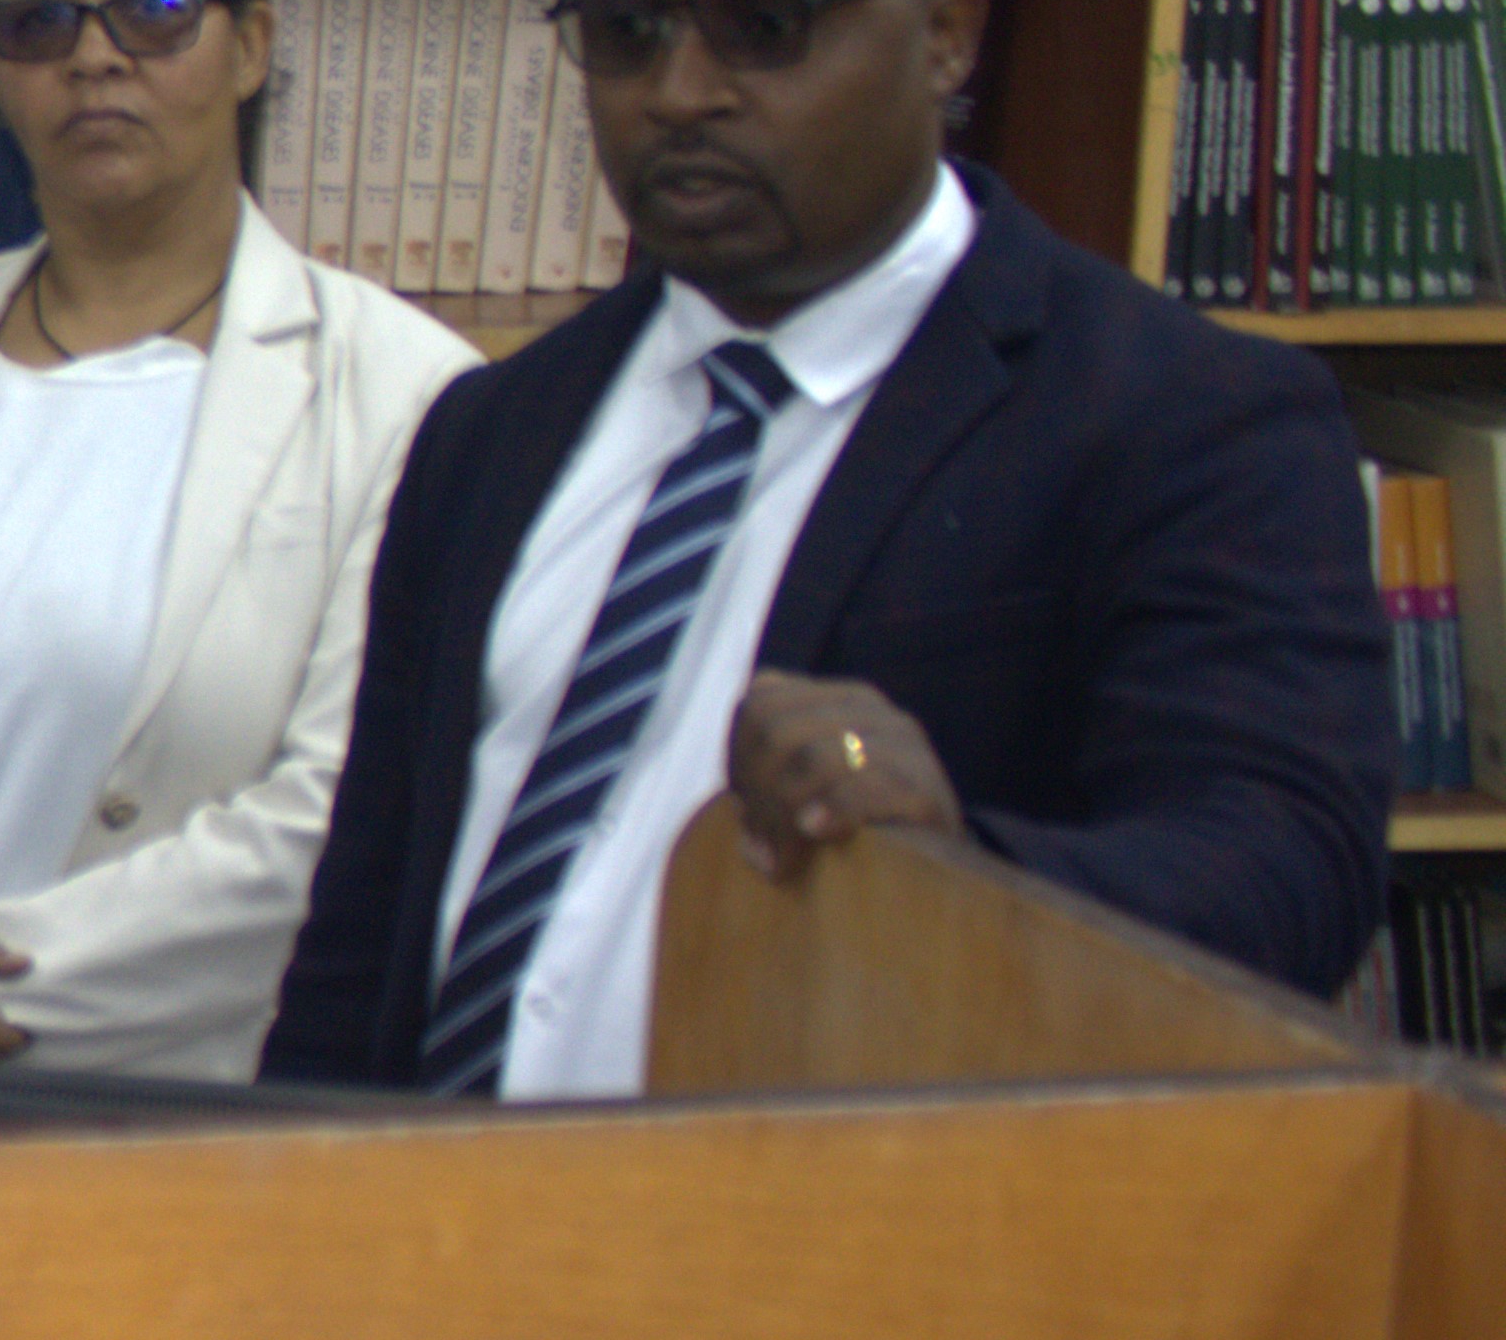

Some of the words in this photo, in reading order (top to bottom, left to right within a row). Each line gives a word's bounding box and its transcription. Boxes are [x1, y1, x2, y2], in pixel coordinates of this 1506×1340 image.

[321, 89, 345, 164] DISEASES
[368, 89, 392, 164] DISEASES
[413, 87, 437, 161] DISEASES
[457, 86, 482, 161] DISEASES
[509, 129, 534, 234] ENDOCRINE
